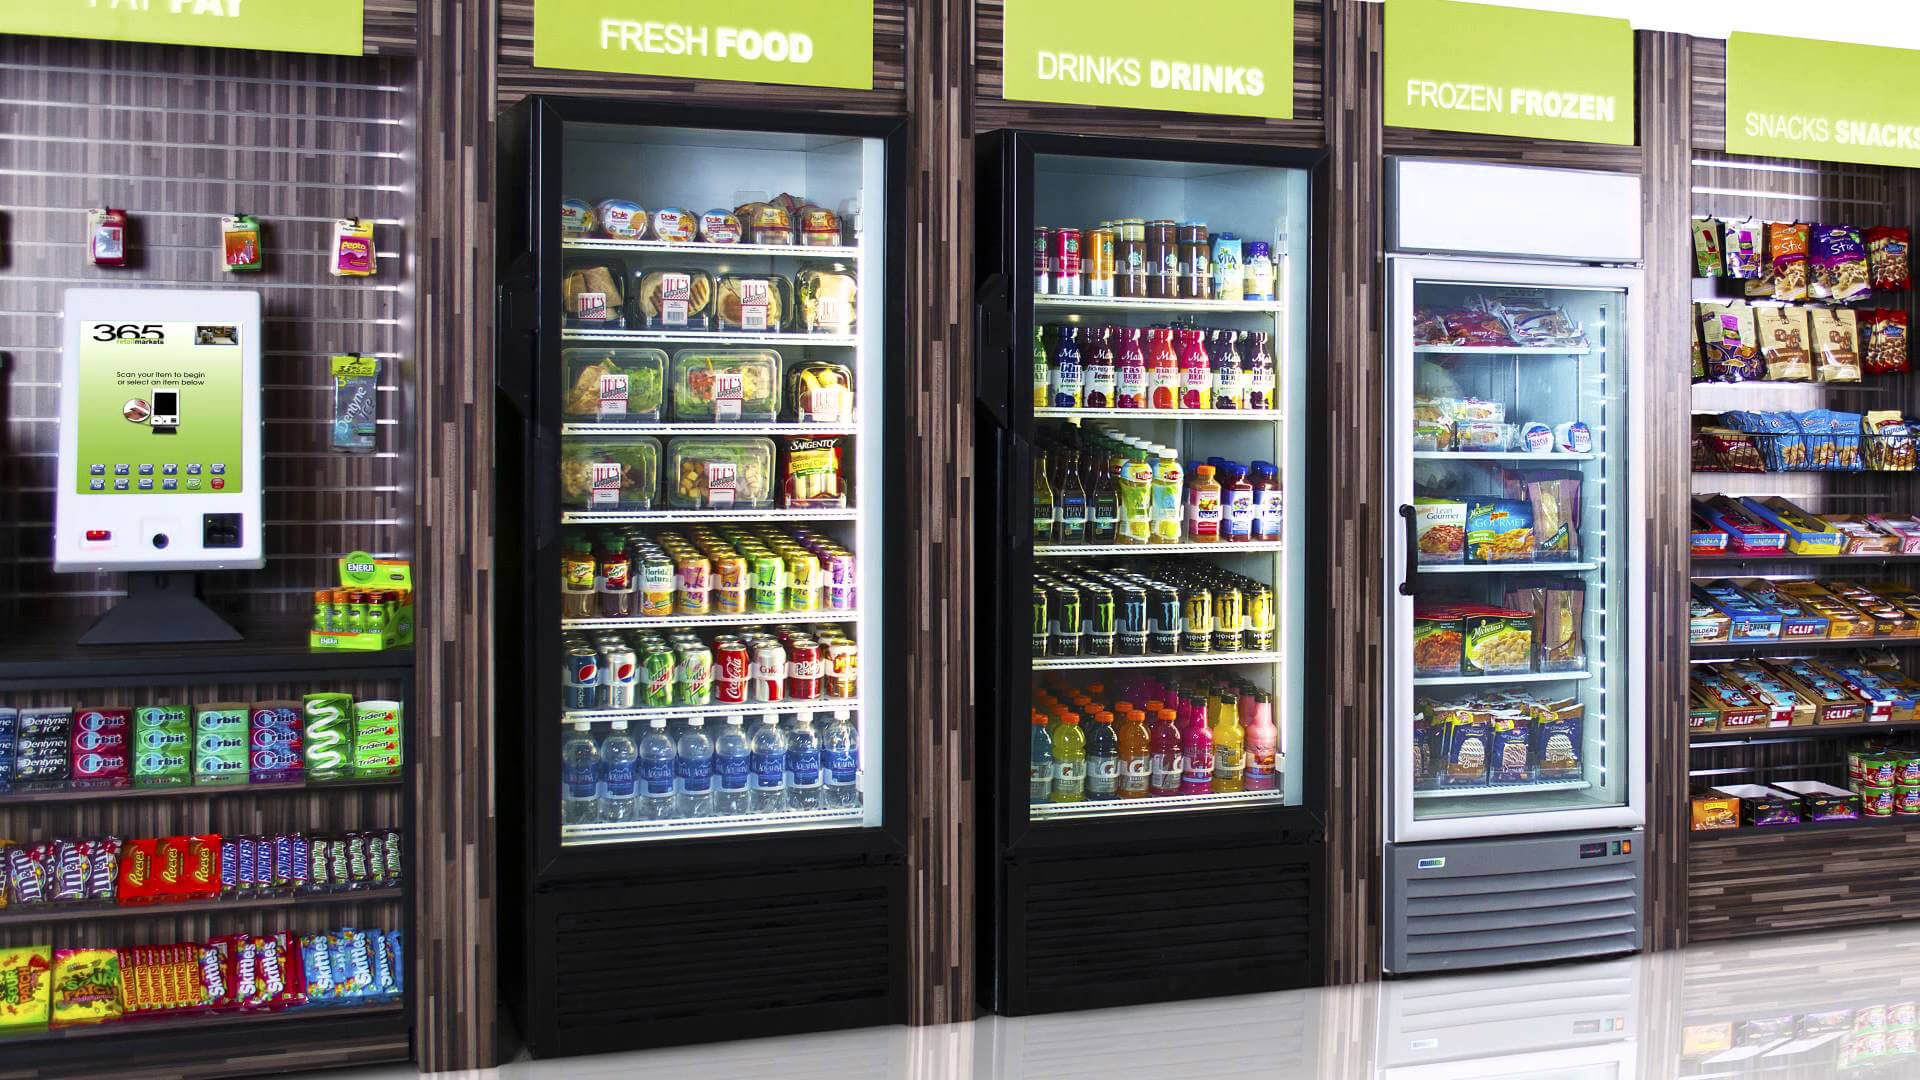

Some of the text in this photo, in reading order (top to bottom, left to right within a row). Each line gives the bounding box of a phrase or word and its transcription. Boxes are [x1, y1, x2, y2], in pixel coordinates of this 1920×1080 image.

[600, 18, 814, 64] FRESH FOOD
[1037, 50, 1265, 97] DRINKS DRINKS
[1406, 79, 1616, 122] FROZEN FROZEN
[1744, 111, 1831, 142] SNACKS
[93, 324, 165, 342] 365
[116, 371, 136, 379] Scan
[137, 373, 155, 381] your
[183, 371, 206, 381] begin
[337, 386, 367, 433] Dentyne
[1475, 518, 1526, 527] GOURMET
[1791, 625, 1814, 634] CLIF
[26, 717, 69, 726] Dentyne
[140, 707, 186, 727] Orbit
[199, 711, 241, 731] Orbit
[357, 712, 387, 720] Trident
[1732, 715, 1754, 725] CLIF
[1830, 709, 1852, 719] CLIF
[141, 730, 187, 749] Orbit
[357, 726, 388, 736] Trident
[24, 740, 66, 749] Dentyne
[199, 733, 242, 753] Orbit
[358, 741, 389, 751] Trident
[24, 758, 64, 767] Dentyne
[139, 752, 185, 772] Orbit
[199, 756, 242, 775] Orbit
[359, 757, 390, 767] Trident
[222, 842, 237, 886] SNICKERS
[239, 838, 254, 883] SNICKERS
[257, 840, 272, 883] SNICKERS
[277, 836, 292, 879] SNICKERS
[293, 838, 309, 881] SNICKERS
[240, 943, 257, 995] Skittles
[263, 941, 284, 994] Skittles
[315, 935, 335, 990] Skittles
[351, 932, 372, 986] Skittles
[378, 935, 394, 989] Skittles
[203, 948, 226, 997] Skittles
[6, 970, 19, 1004] SOUR
[18, 967, 33, 1003] PATCH
